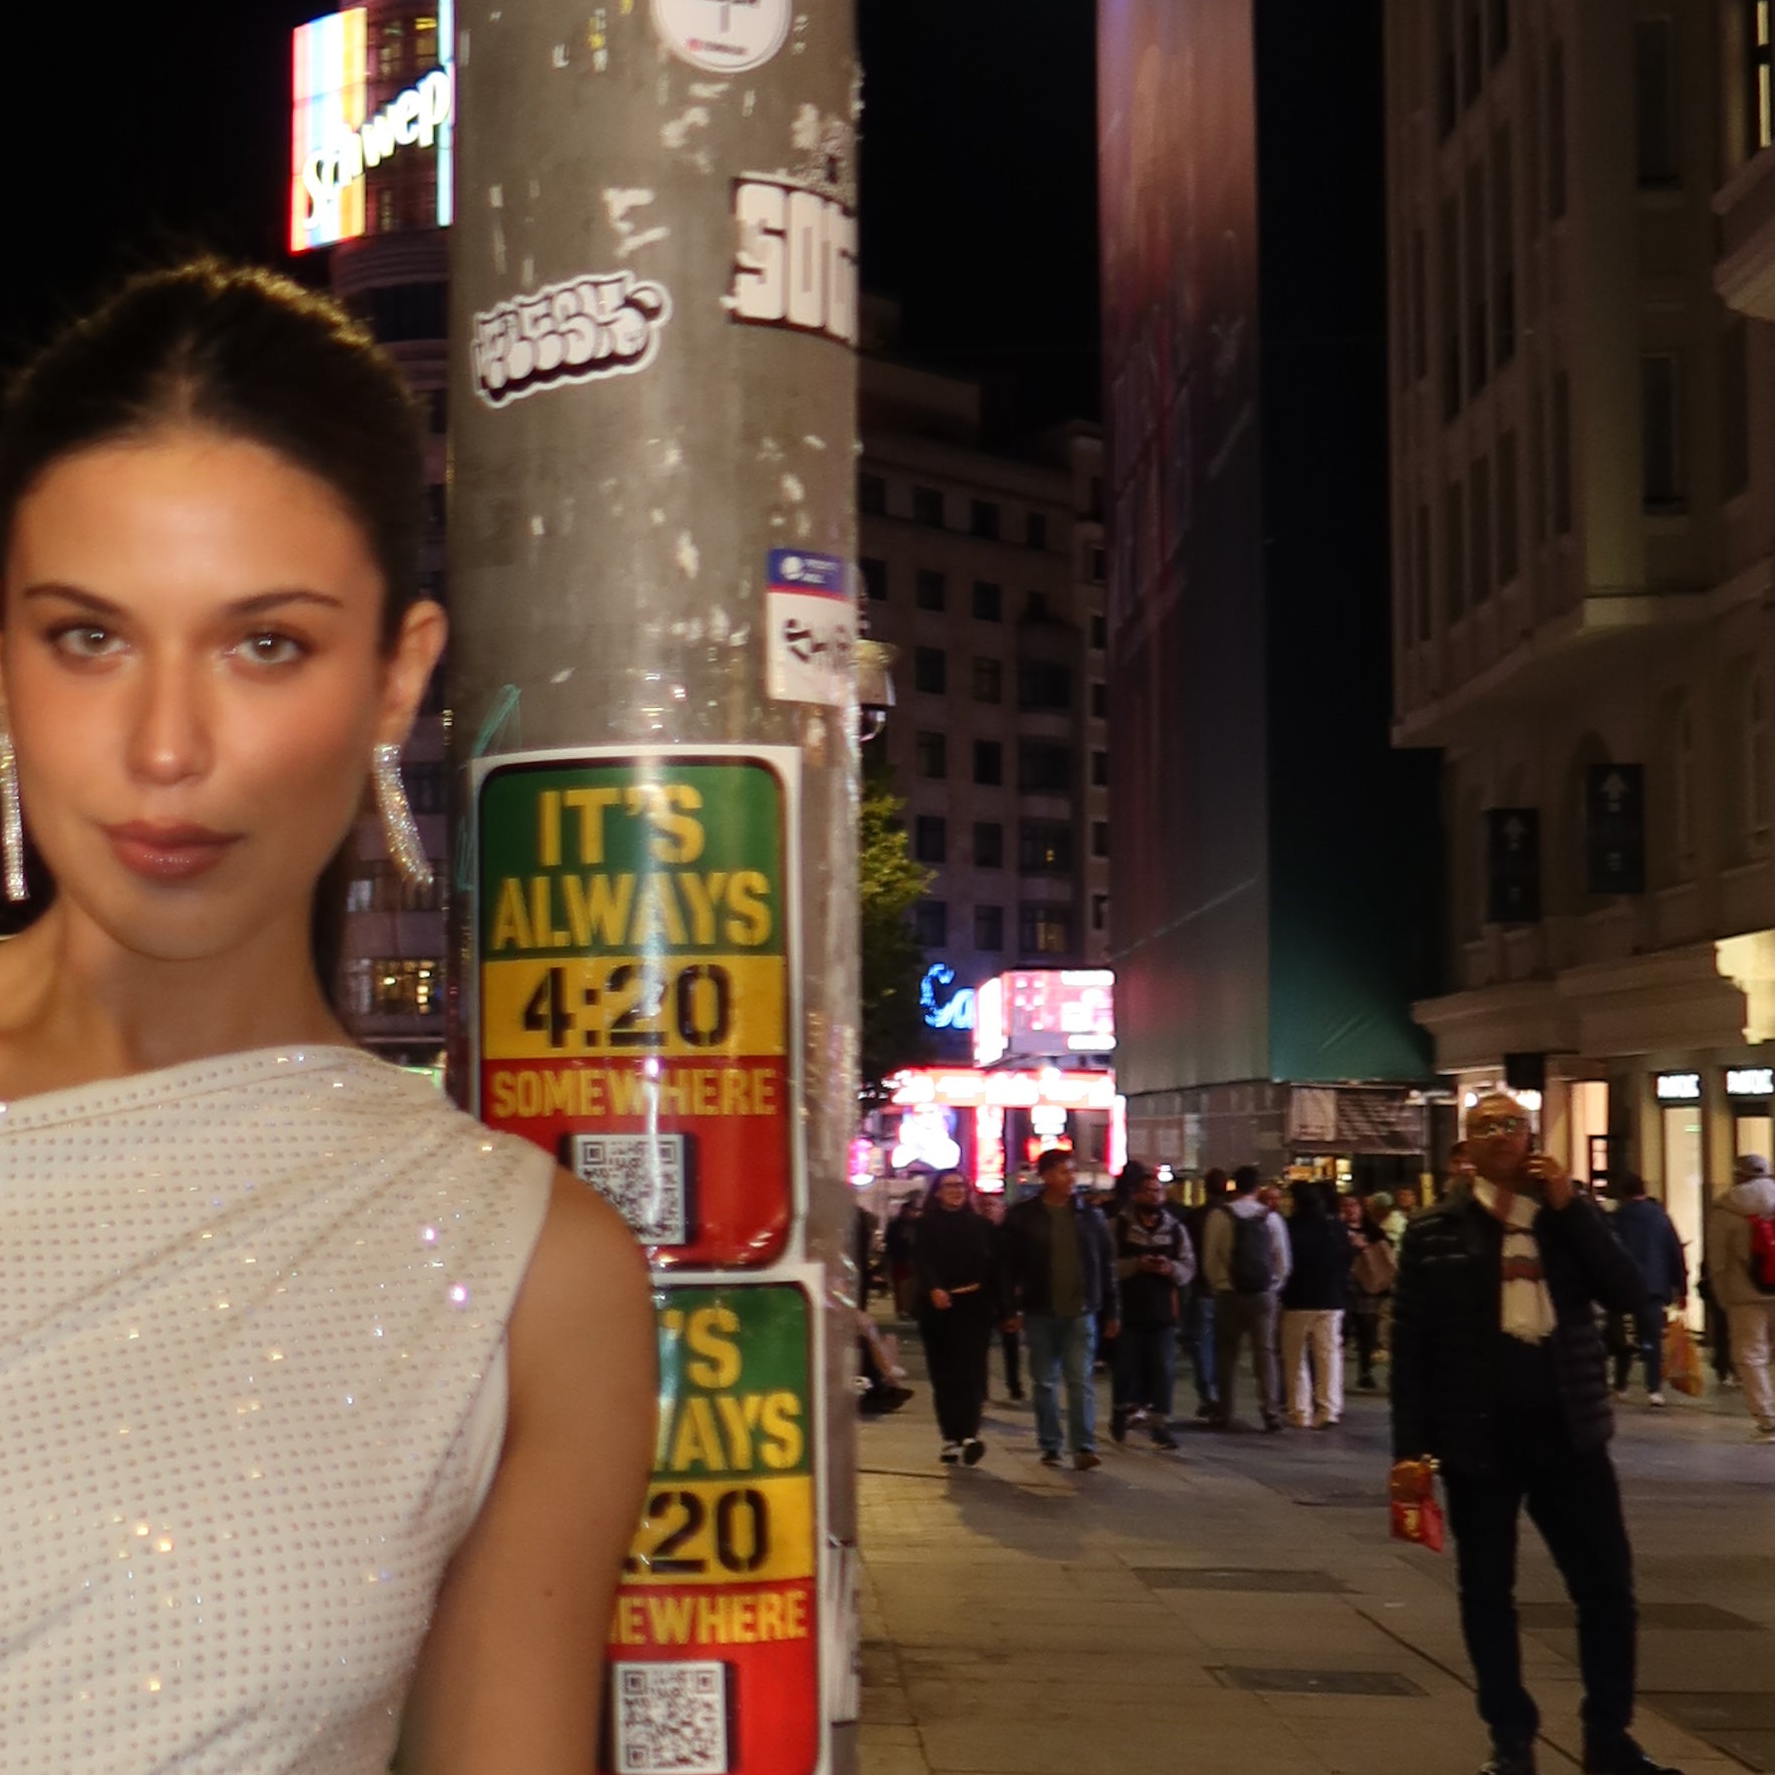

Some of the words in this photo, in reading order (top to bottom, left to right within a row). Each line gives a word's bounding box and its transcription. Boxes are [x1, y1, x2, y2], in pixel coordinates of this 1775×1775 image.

[538, 784, 705, 867] IT'S
[490, 871, 773, 950] ALWAYS
[521, 964, 732, 1049] 4:20
[493, 1068, 777, 1119] SOMEWHERE
[654, 1391, 805, 1472] AYS
[623, 1488, 771, 1575] 20
[610, 1591, 808, 1646] EWHERE
